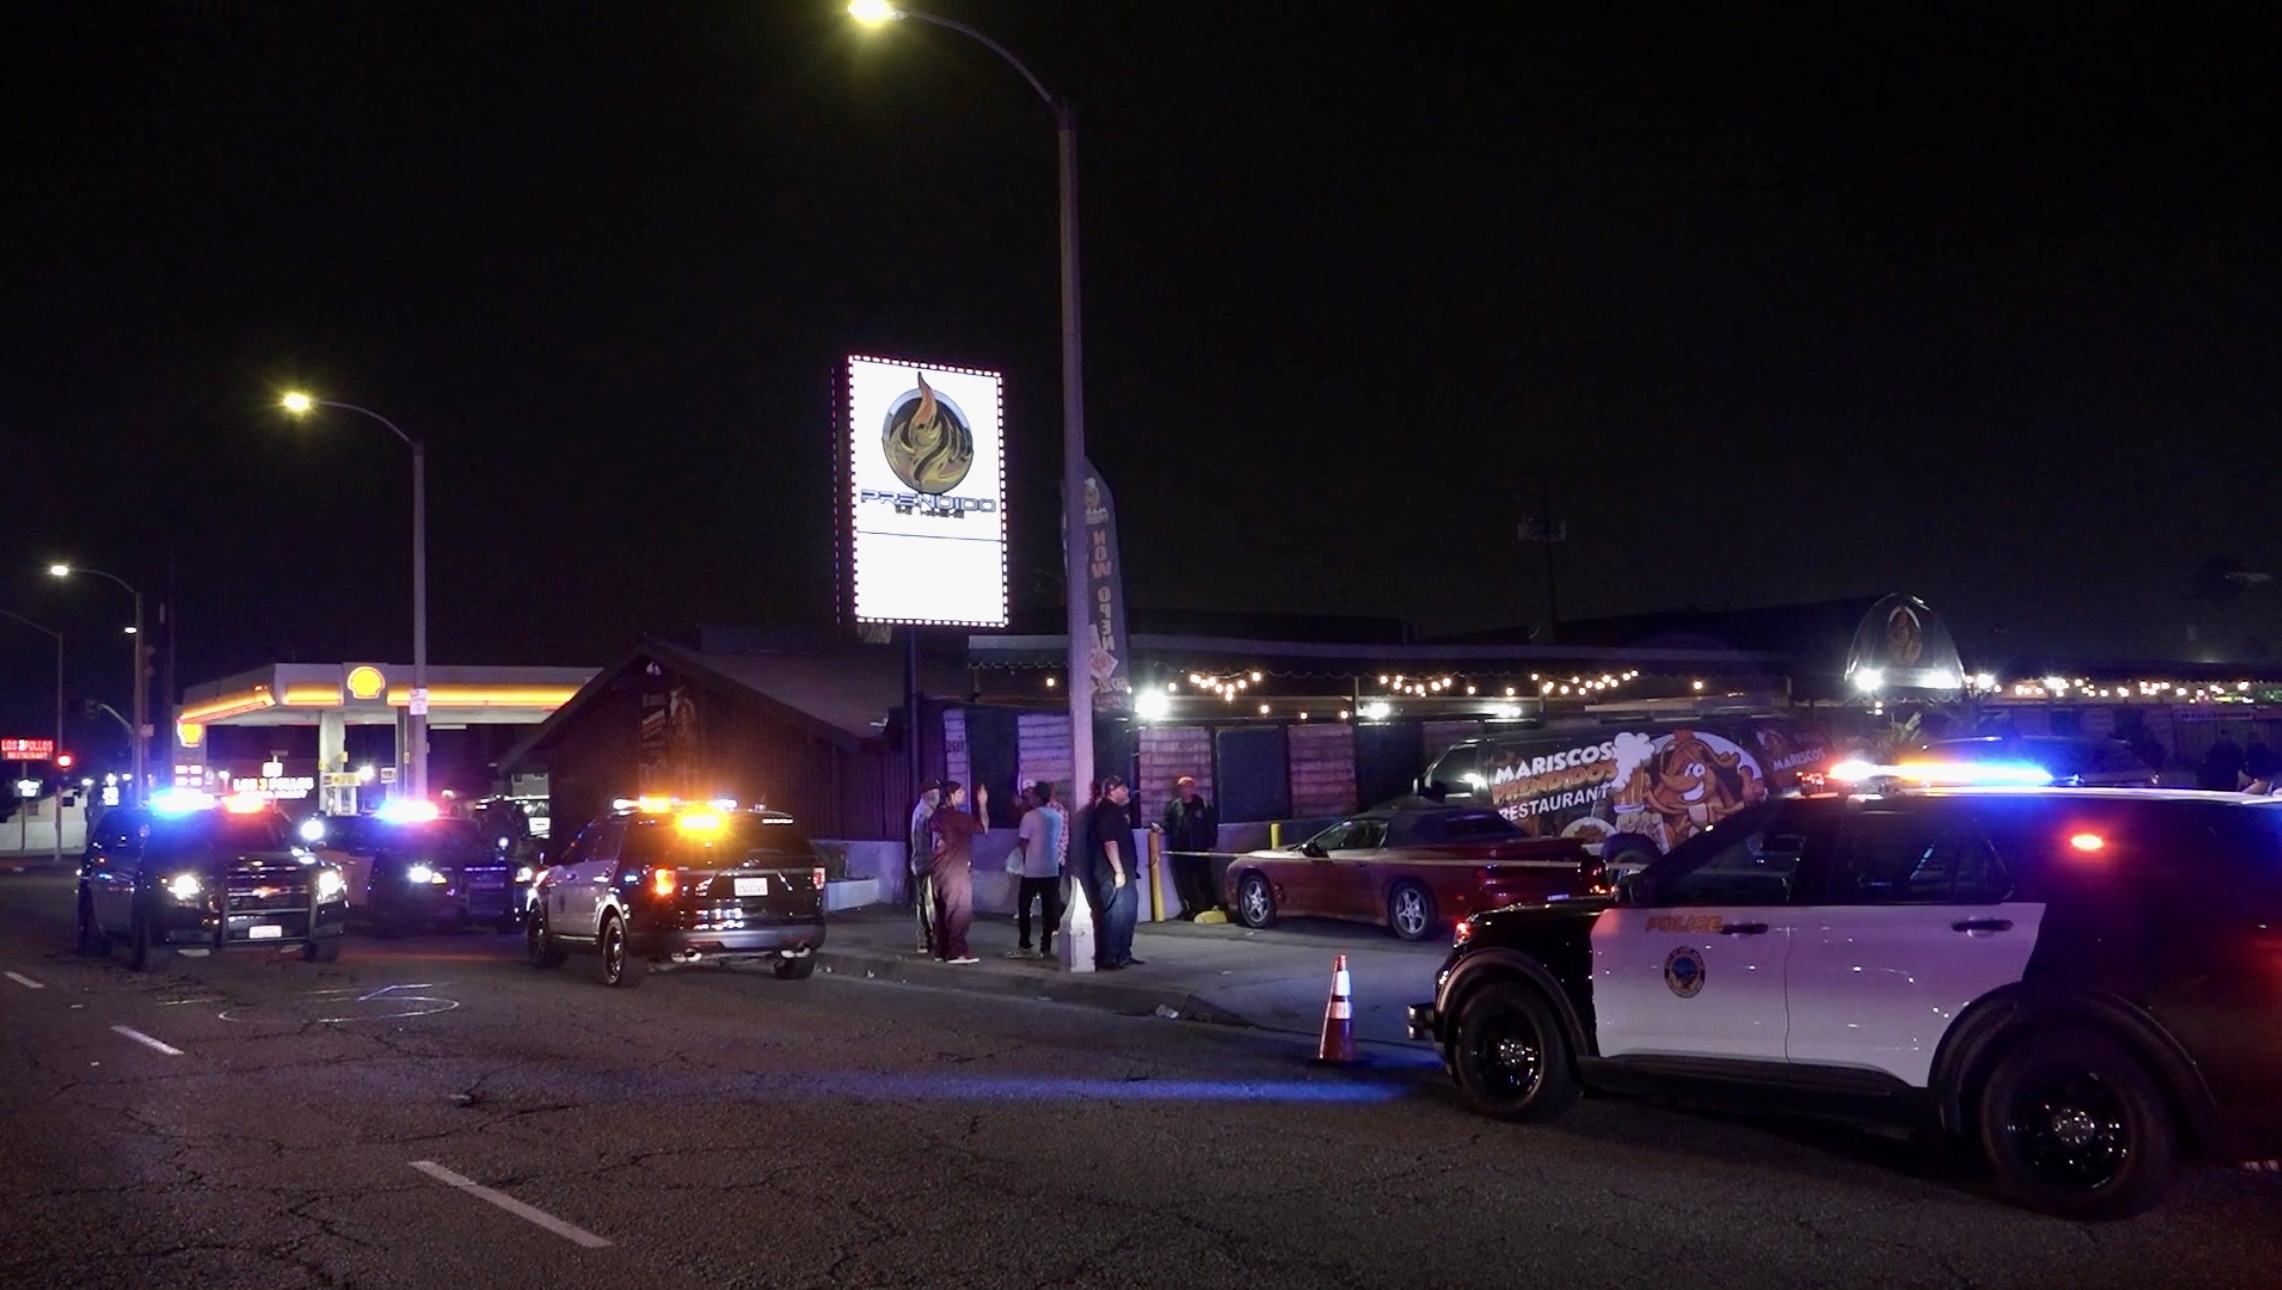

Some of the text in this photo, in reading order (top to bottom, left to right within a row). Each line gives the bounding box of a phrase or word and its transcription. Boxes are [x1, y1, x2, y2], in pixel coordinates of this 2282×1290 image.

[860, 489, 997, 513] PRENDIDO
[2, 740, 17, 751] LOS
[25, 740, 53, 752] POLLOS
[1493, 740, 1616, 786] MARISCOS
[1772, 747, 1827, 772] MARISCOS
[233, 777, 314, 792] LOS 3 POLLOS
[1499, 781, 1613, 822] RESTAURANT
[1644, 915, 1723, 934] POLICE
